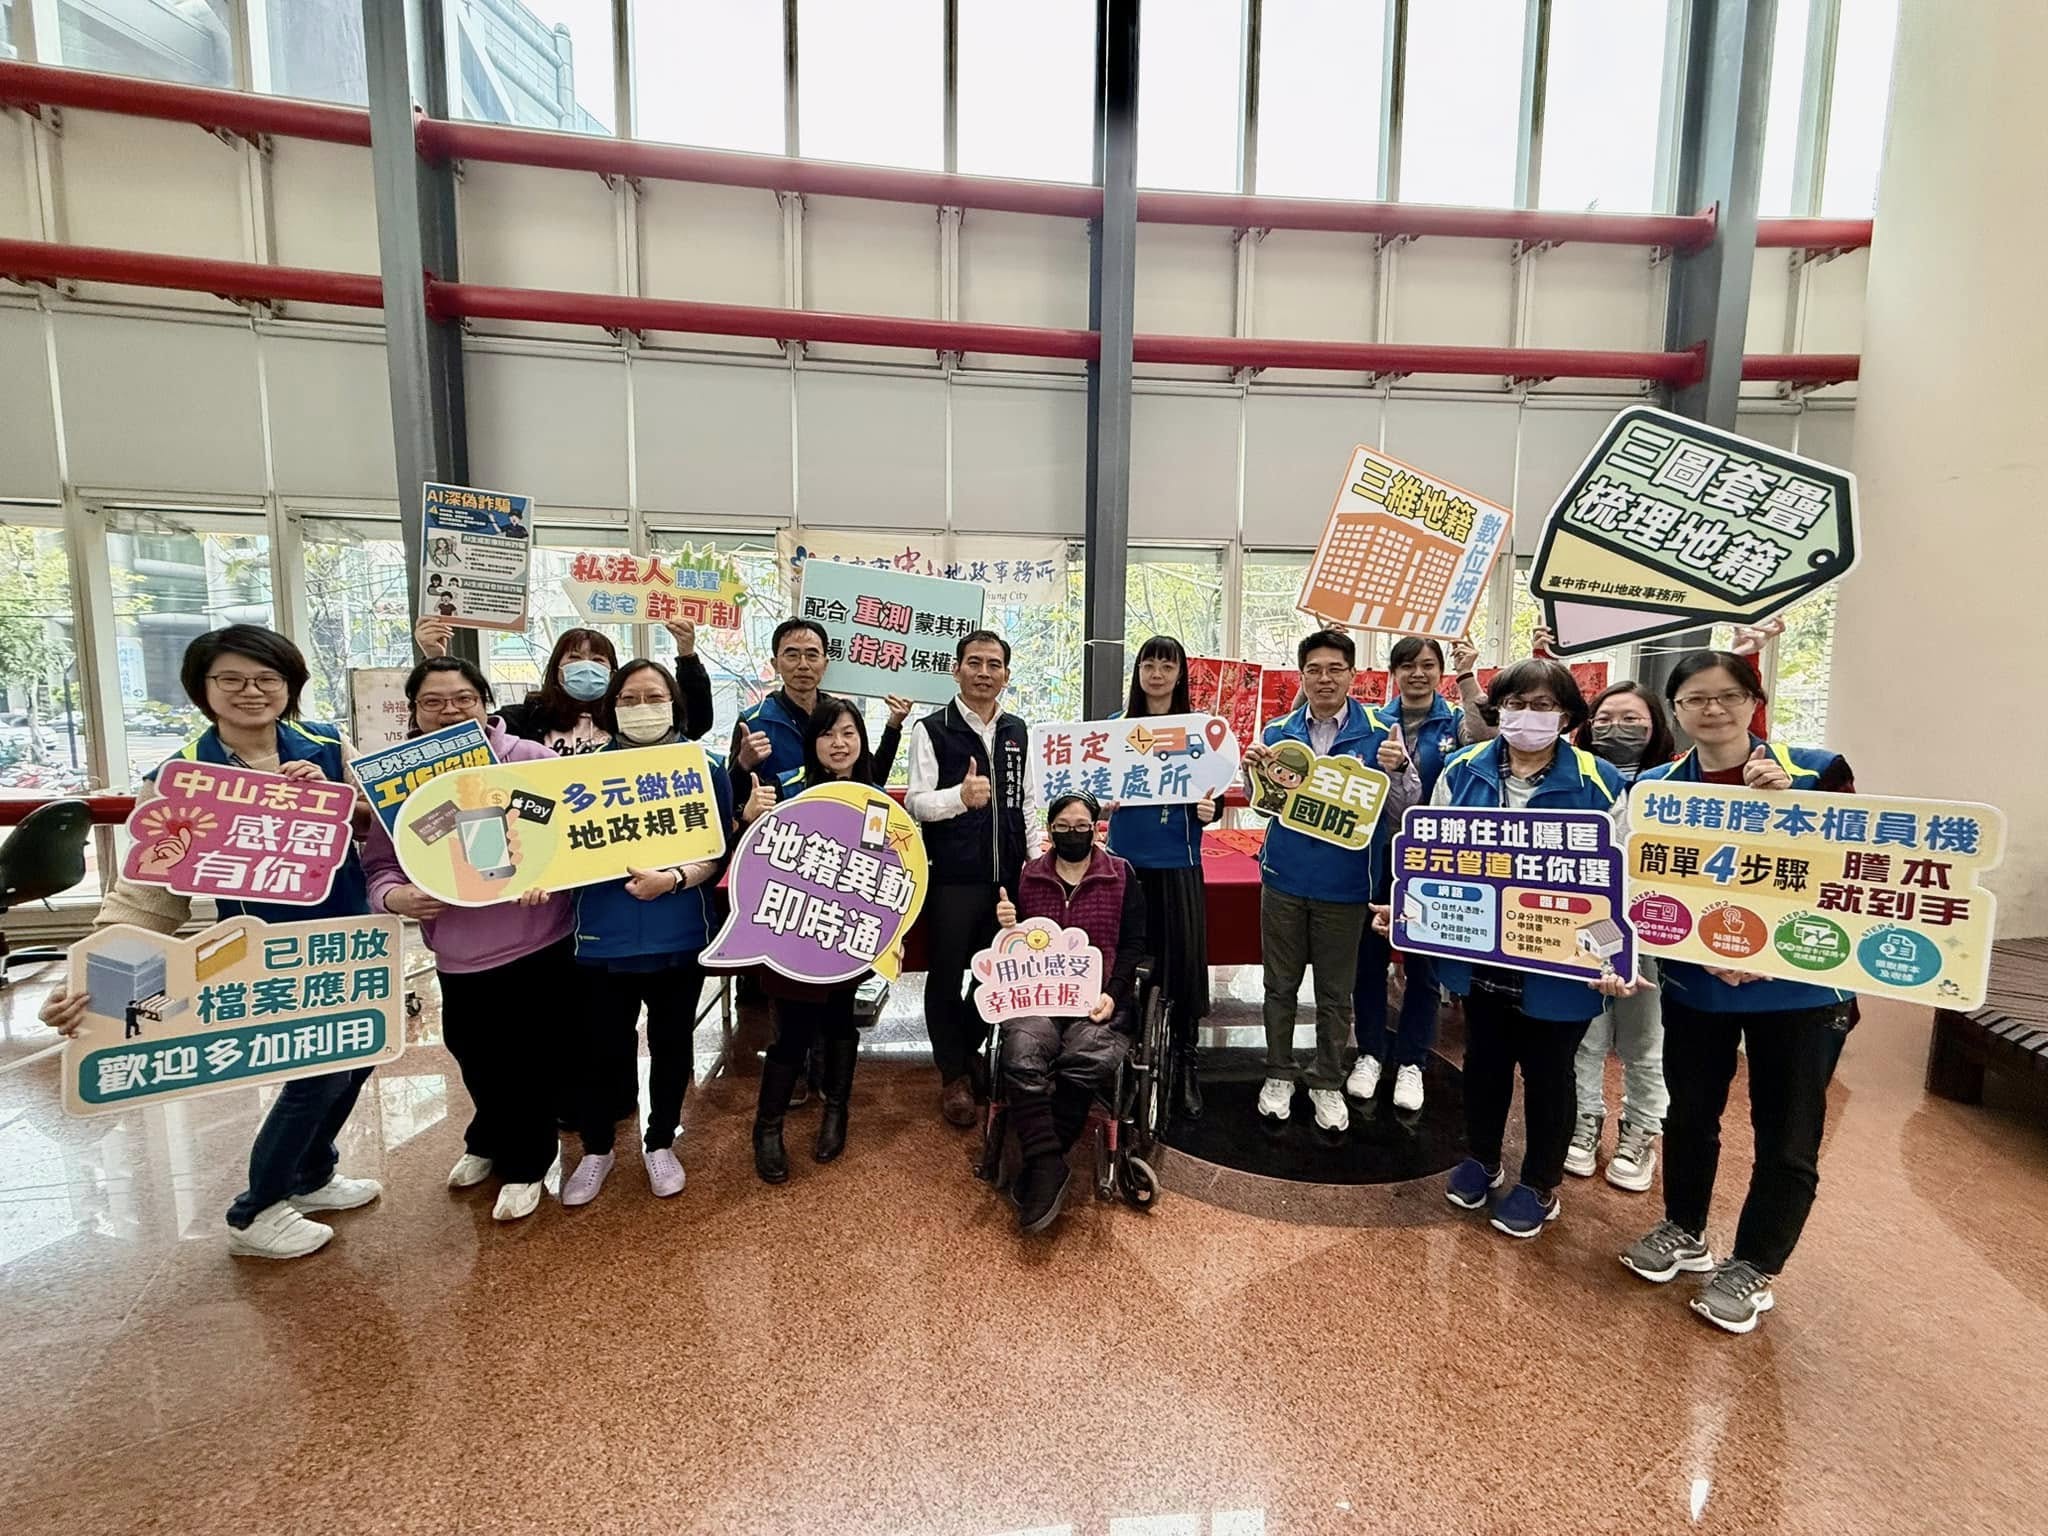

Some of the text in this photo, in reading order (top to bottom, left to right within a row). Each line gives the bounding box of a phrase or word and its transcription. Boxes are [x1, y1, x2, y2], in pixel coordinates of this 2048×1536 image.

[1352, 458, 1477, 544] 三維地籍
[1606, 426, 1833, 539] 三圖套疊
[1573, 476, 1791, 594] 梳理地籍
[1440, 513, 1503, 634] 數位城市
[1548, 575, 1688, 603] 臺中市中山地政事務所
[911, 648, 958, 674] 保權
[1043, 731, 1111, 766] 指定
[173, 770, 341, 816] 中山志工
[562, 767, 704, 814] 多元繳納
[1043, 763, 1192, 802] 送達處所
[1308, 765, 1381, 811] 全民
[524, 800, 551, 818] Pay
[568, 802, 709, 850] 地政規費
[1288, 793, 1359, 839] 國防
[1643, 792, 1981, 855] 地籍謄本櫃員機
[224, 815, 337, 857] 感恩
[1412, 817, 1599, 852] 申辦住址隱匿
[193, 851, 307, 893] 有你
[753, 815, 916, 915] 地籍異動
[1404, 847, 1610, 887] 多元管道任你選
[1842, 850, 1953, 890] 謄本
[752, 879, 882, 962] 即時通
[1817, 882, 1970, 926] 就到手
[264, 927, 390, 971] 已開放
[996, 954, 1091, 984] 用心感受
[197, 966, 391, 1025] 檔案應用
[985, 983, 1081, 1014] 幸福在握
[98, 1017, 375, 1096] 歡迎多加利用
